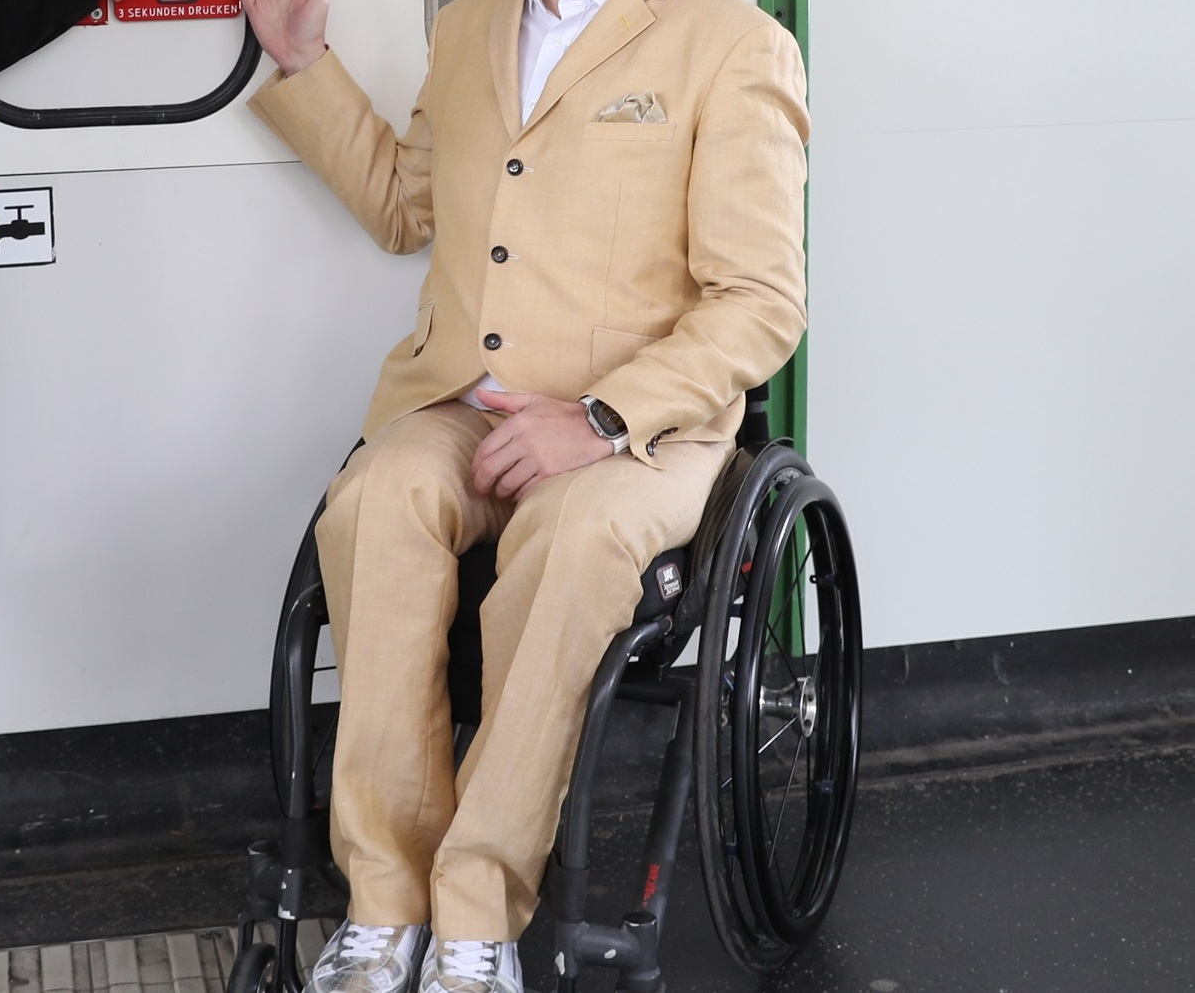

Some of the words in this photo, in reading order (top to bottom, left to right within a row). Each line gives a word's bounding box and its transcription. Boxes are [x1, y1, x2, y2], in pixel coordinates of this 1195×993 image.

[118, 8, 124, 18] 3
[128, 7, 185, 18] SEKUNDEN
[188, 4, 238, 15] DRÜCKEN
